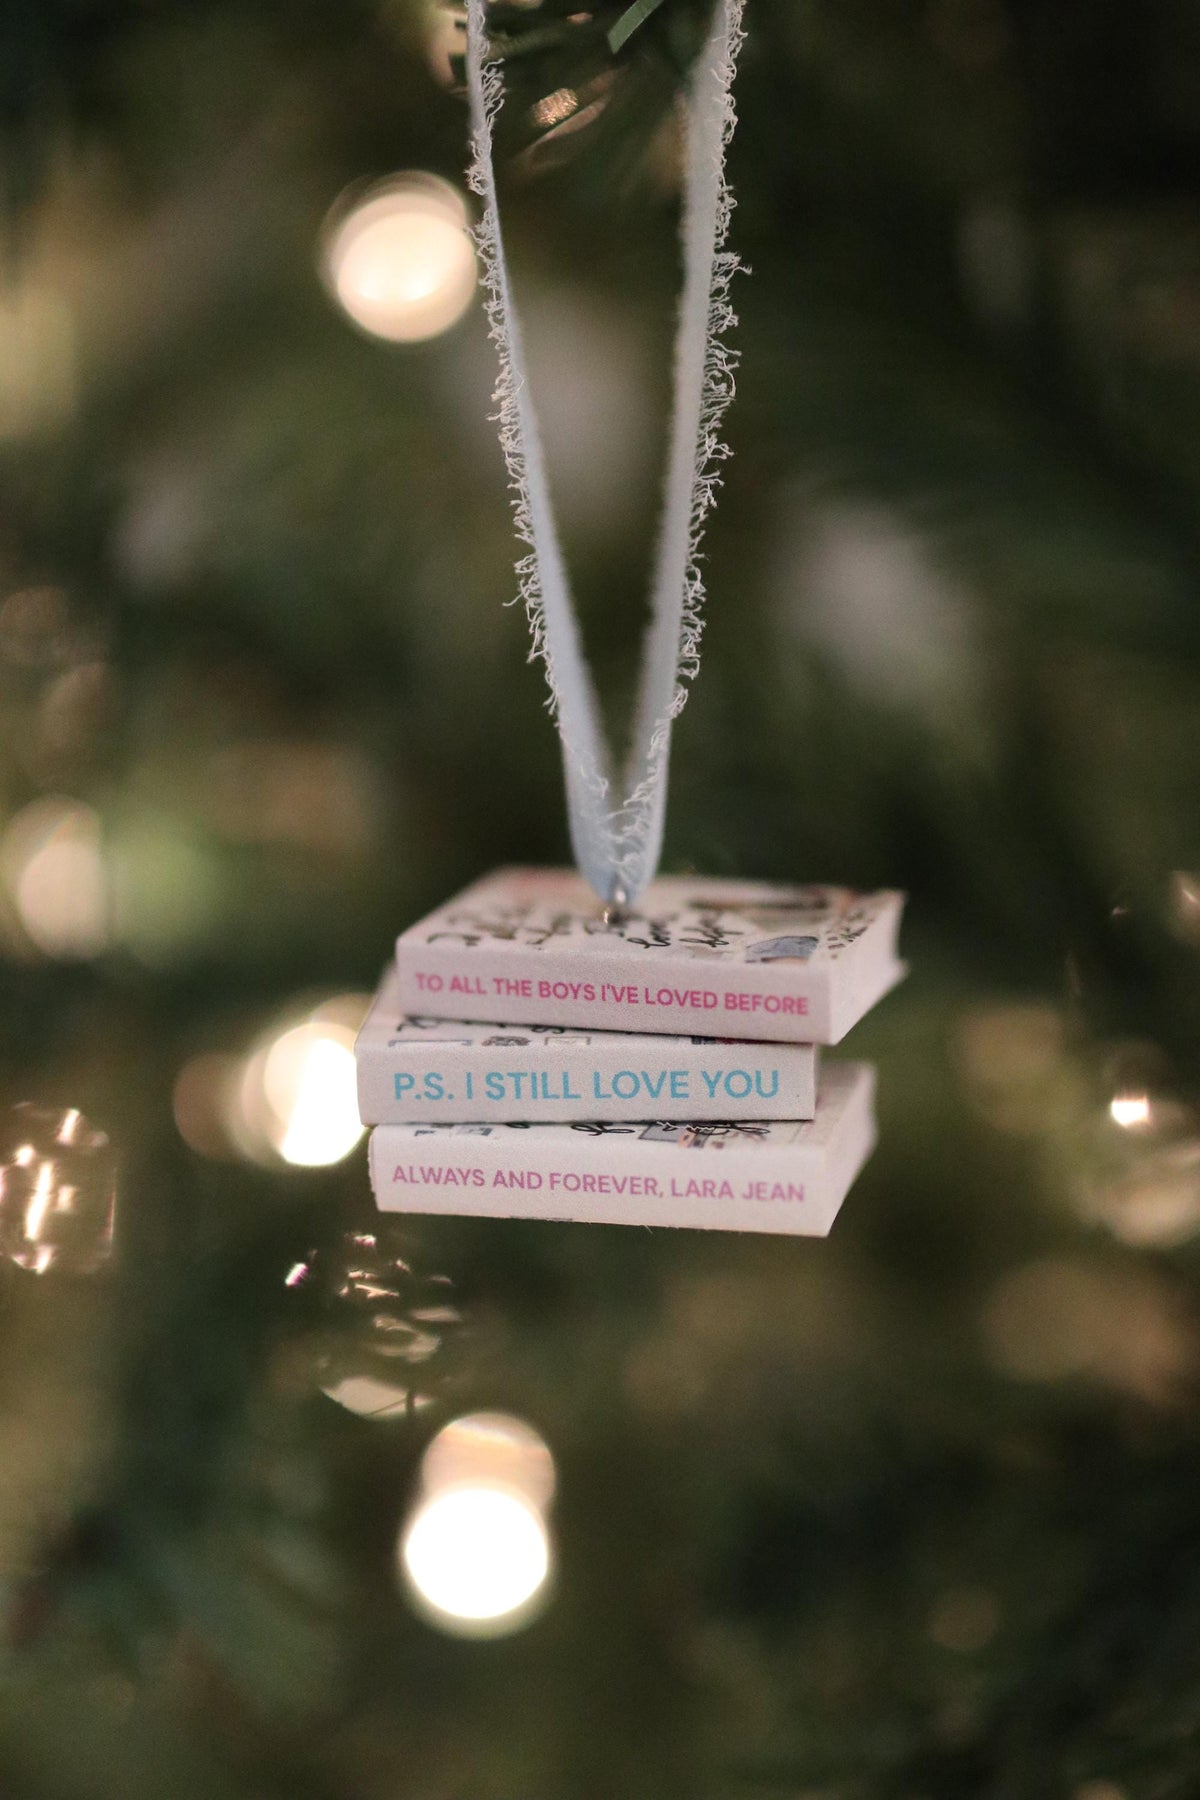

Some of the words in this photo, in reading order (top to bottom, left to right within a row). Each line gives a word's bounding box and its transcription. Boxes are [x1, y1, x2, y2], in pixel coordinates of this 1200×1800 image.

[415, 972, 444, 993] TO
[449, 975, 486, 996] ALL
[494, 977, 532, 998] THE
[538, 980, 596, 1002] BOYS
[601, 984, 639, 1004] I'VE
[644, 988, 718, 1010] LOVED
[724, 992, 809, 1016] BEFORE
[393, 1072, 455, 1102] P.S.
[465, 1071, 473, 1100] I
[485, 1070, 582, 1101] STILL
[592, 1069, 690, 1101] LOVE
[700, 1069, 781, 1100] YOU
[391, 1164, 486, 1188] ALWAYS
[492, 1168, 544, 1191] AND
[548, 1171, 664, 1199] FOREVER,
[670, 1177, 735, 1200] LARA
[742, 1181, 806, 1204] JEAN
